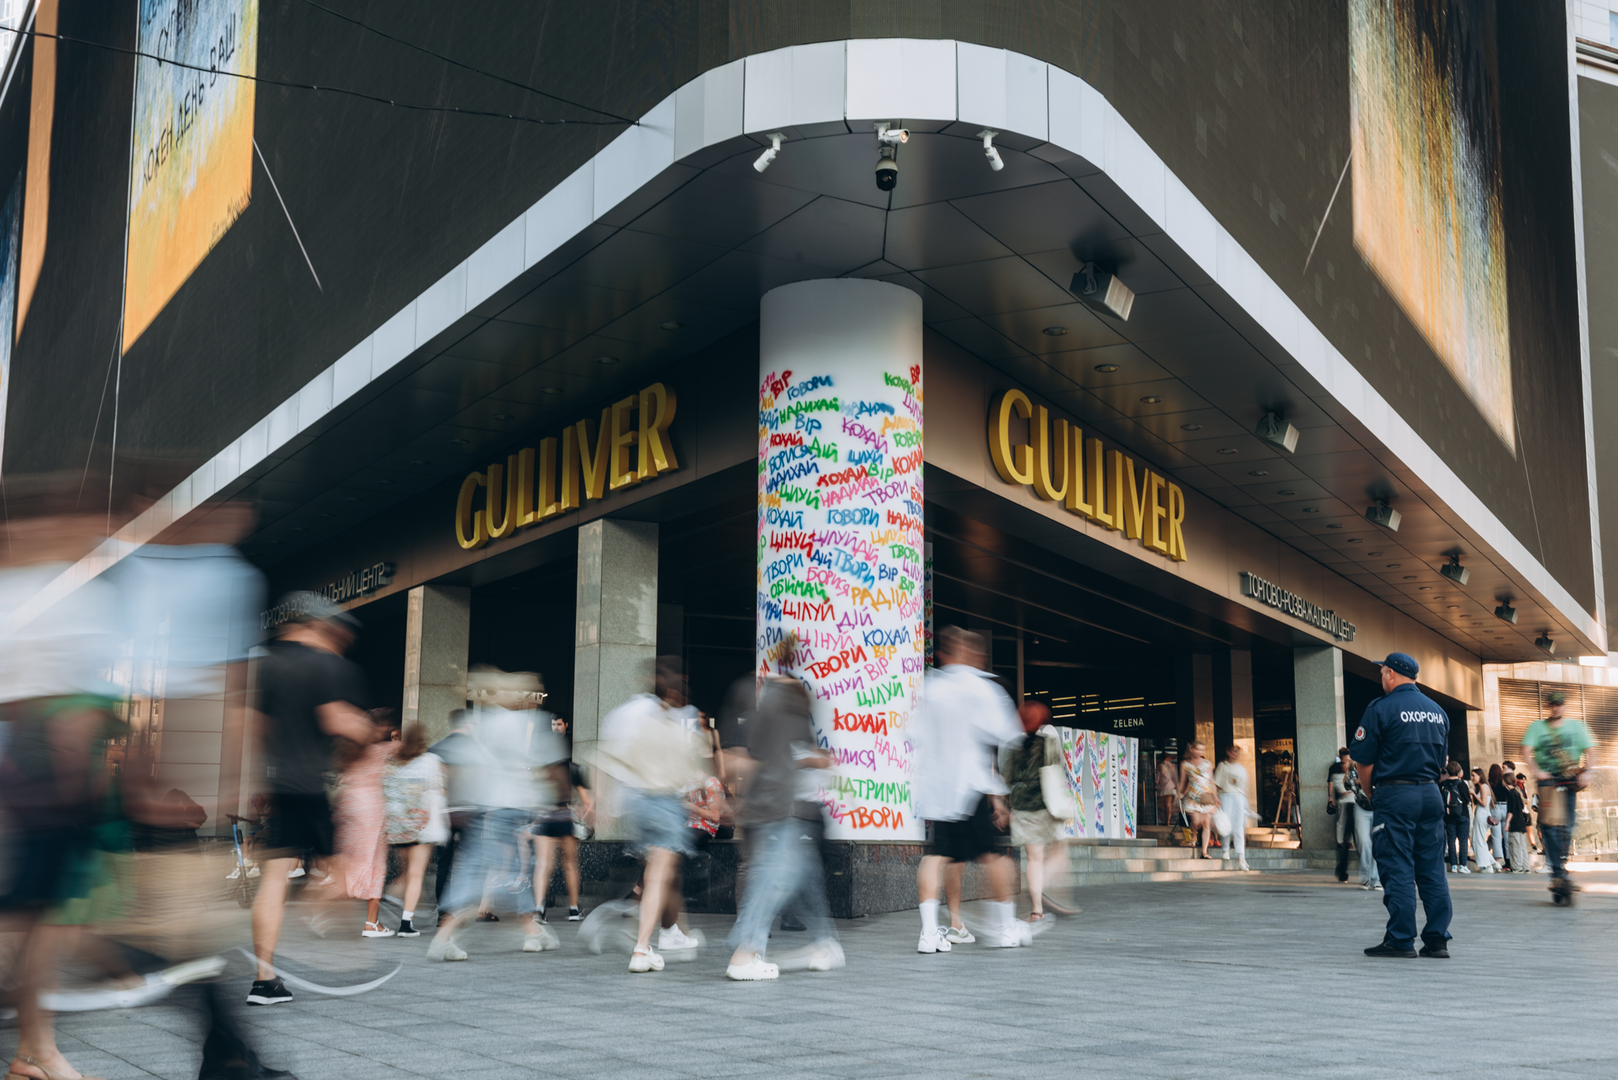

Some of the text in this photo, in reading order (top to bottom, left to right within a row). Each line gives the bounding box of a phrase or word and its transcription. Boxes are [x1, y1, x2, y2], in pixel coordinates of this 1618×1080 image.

[176, 70, 205, 150] ДЕНЬ
[210, 13, 235, 88] ВАШ
[770, 369, 793, 400] ВІР
[787, 375, 833, 400] ГОВОРИ
[884, 372, 915, 398] КОХАЙ
[779, 398, 840, 424] НАДИХАЙ
[795, 413, 822, 436] ВІР
[842, 416, 888, 454] КОХАЙ
[770, 430, 804, 448] КОХАЙ
[809, 436, 838, 463] ДІЙ
[455, 381, 679, 549] GULLIVER
[768, 444, 812, 476] БОРИСЯ
[868, 462, 894, 483] ВІР
[766, 454, 819, 494] НАДИХАЙ
[816, 465, 869, 488] КОХАЙ
[988, 387, 1187, 562] GULLIVER
[820, 477, 879, 508] НАДИХАЙ
[862, 480, 909, 506] ТВОРИ
[766, 507, 804, 530] КОХАЙ
[828, 508, 880, 528] ГОВОРИ
[770, 530, 816, 558] ЦІНУЙ
[812, 528, 860, 551] ЦІЛУЙ
[810, 549, 832, 570] ДІЙ
[854, 540, 880, 568] ДІЙ
[888, 544, 920, 564] ТВОРИ
[356, 562, 385, 598] ЦЕНТР
[763, 552, 804, 584] ТВОРИ
[834, 548, 875, 589] ТВОРИ
[878, 564, 898, 582] ВІР
[806, 566, 850, 597] БОРИСЯ
[900, 576, 916, 596] ВІР
[783, 597, 836, 622] ЦІЛУЙ
[851, 587, 908, 612] РАДІЙ
[1240, 571, 1356, 642] ТОРГОВО-РОЗВАЖАЛЬНИЙ ЦЕНТР
[836, 606, 874, 634] ДІЙ
[797, 626, 855, 652] ЦІНУЙ
[862, 626, 911, 647] КОХАЙ
[804, 645, 868, 680] ТВОРИ
[872, 645, 898, 660] ВІР
[864, 656, 889, 681] ВІР
[816, 669, 864, 700] ЦІНУЙ
[856, 675, 904, 708] ЦІЛУЙ
[834, 708, 888, 736] КОХАЙ
[1113, 718, 1144, 728] ZELENA
[1400, 710, 1444, 724] ОХОРОНА
[828, 746, 876, 772] ДІЛИСЯ
[842, 806, 904, 830] ТВОРИ
